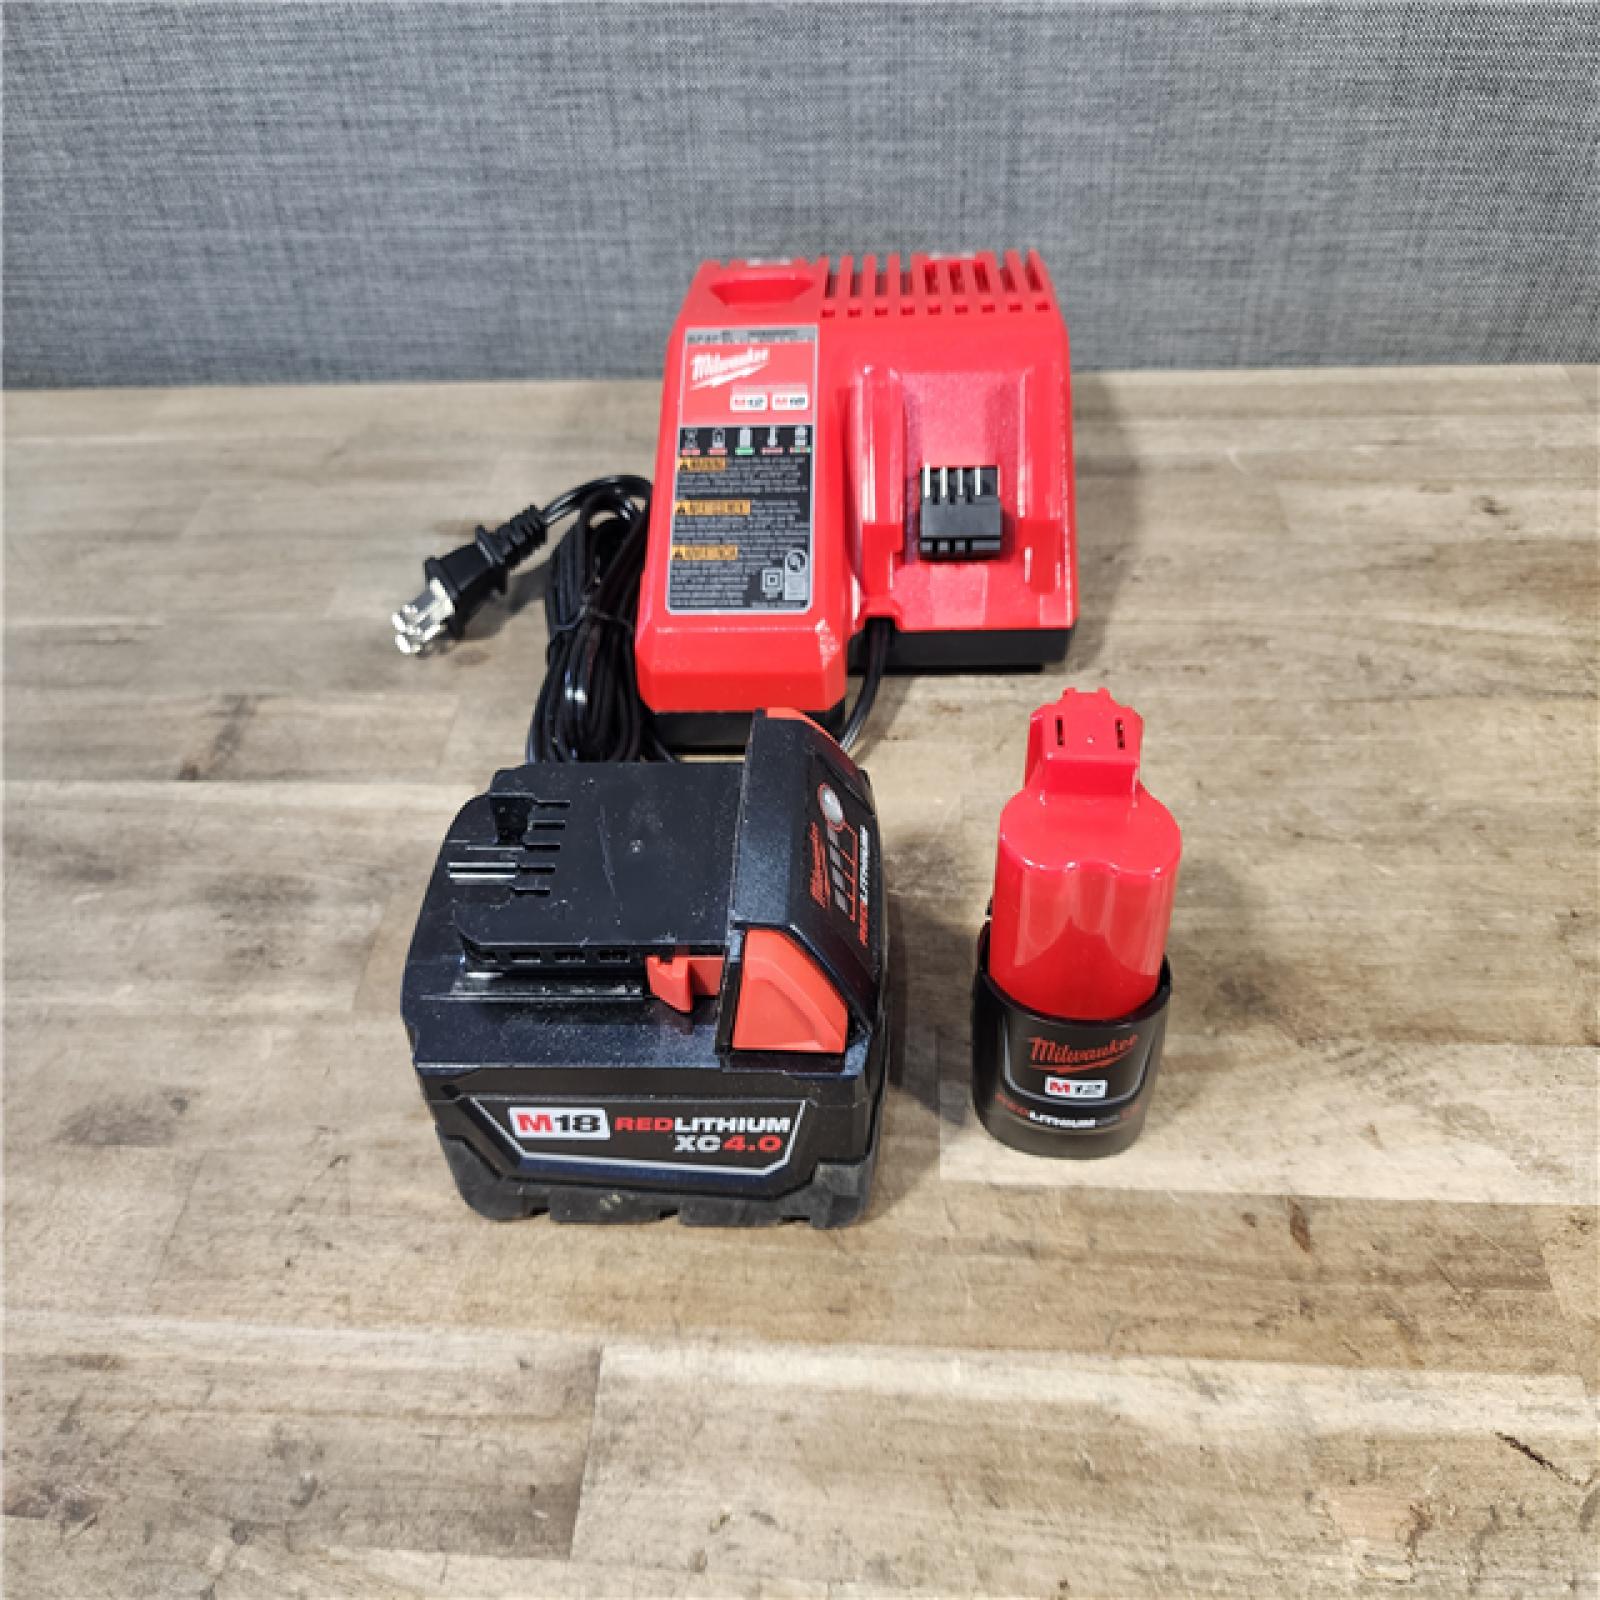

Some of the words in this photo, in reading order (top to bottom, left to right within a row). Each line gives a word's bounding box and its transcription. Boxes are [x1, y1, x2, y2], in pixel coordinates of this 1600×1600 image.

[1029, 1034, 1138, 1063] Milwaukee
[1049, 1081, 1103, 1096] M12
[516, 1114, 602, 1133] M18
[614, 1116, 791, 1134] REDLITHIUM
